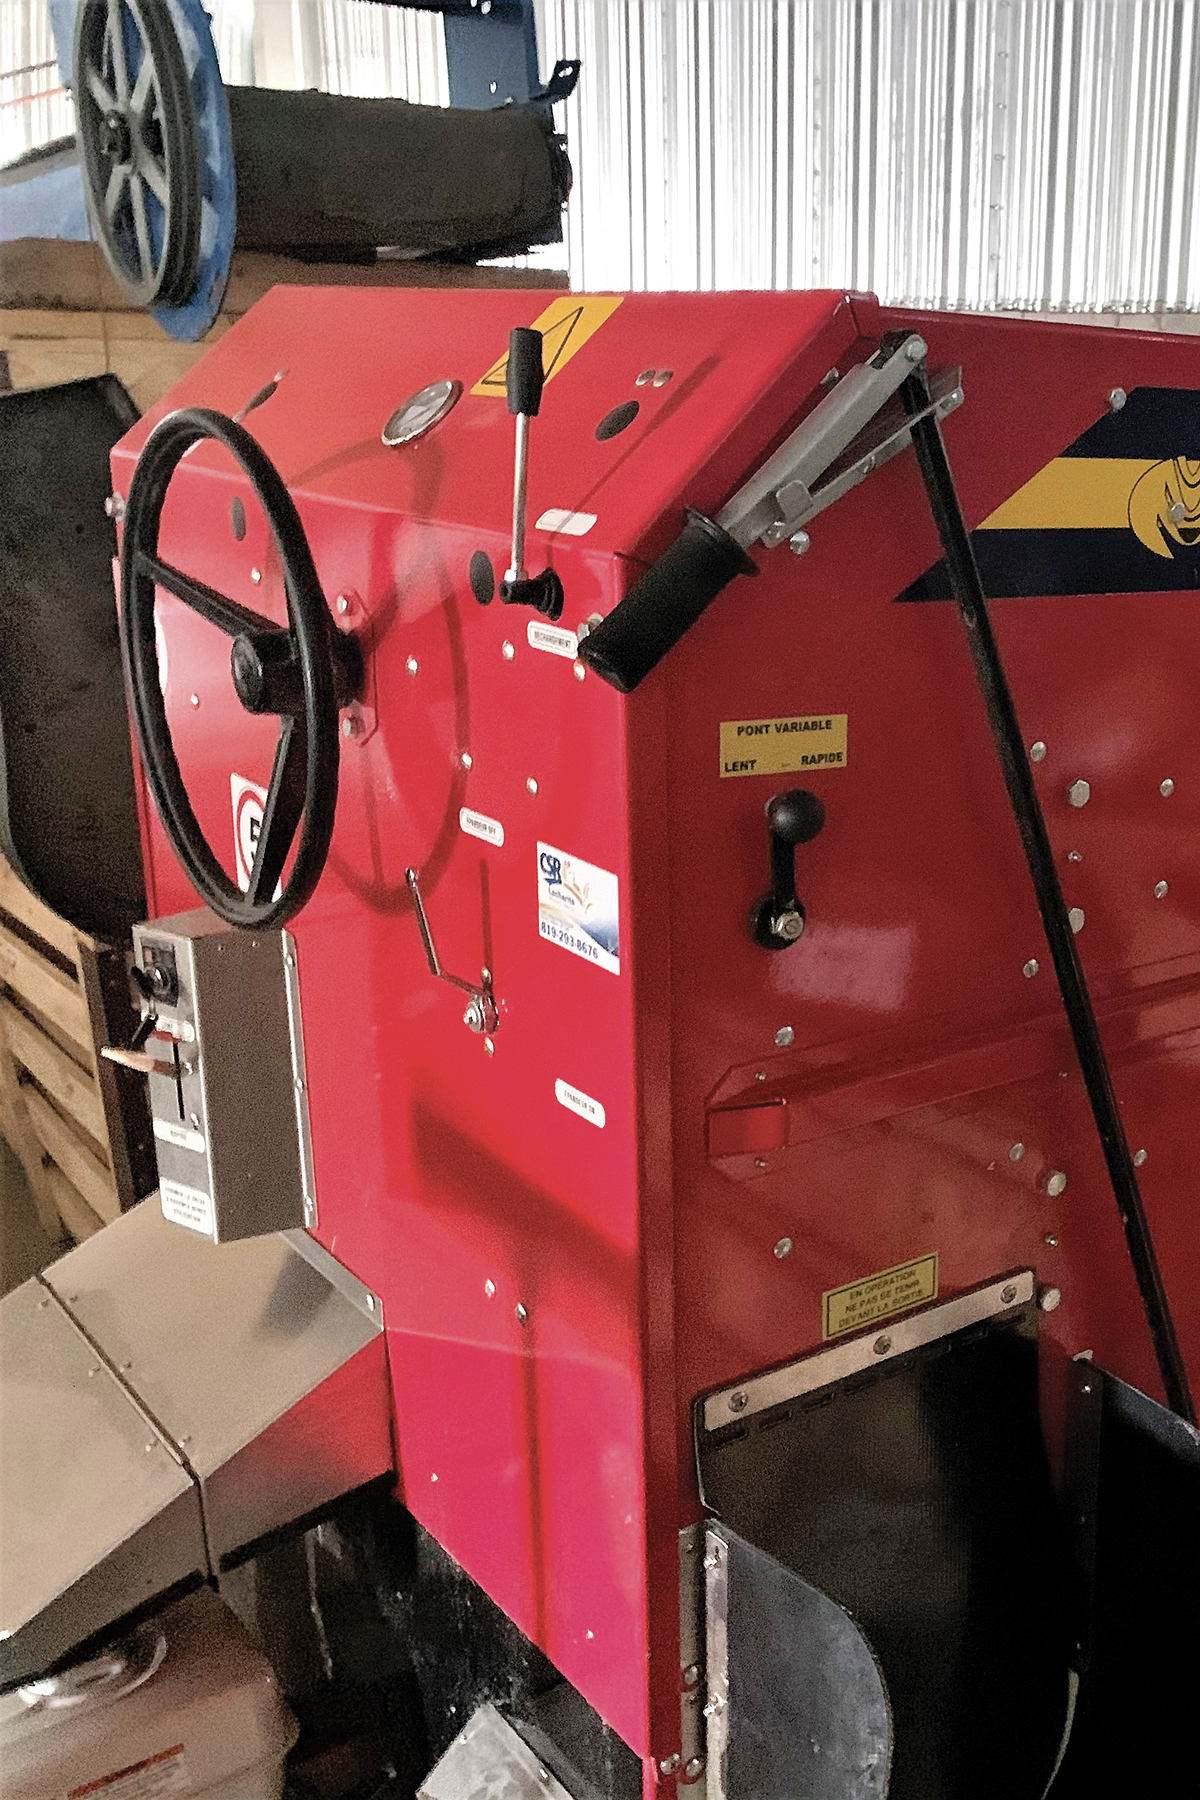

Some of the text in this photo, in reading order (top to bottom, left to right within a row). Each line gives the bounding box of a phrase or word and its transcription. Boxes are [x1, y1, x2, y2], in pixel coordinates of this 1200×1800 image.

[737, 719, 833, 736] PONT VARIABLE
[724, 752, 843, 773] LENT RAPIDE
[541, 921, 599, 960] 819-293-8676
[845, 1302, 857, 1314] NE
[860, 1294, 878, 1307] PAS
[880, 1289, 892, 1301] SE
[849, 1289, 863, 1301] EN
[838, 1289, 924, 1328] DEVANT LA SORTIE
